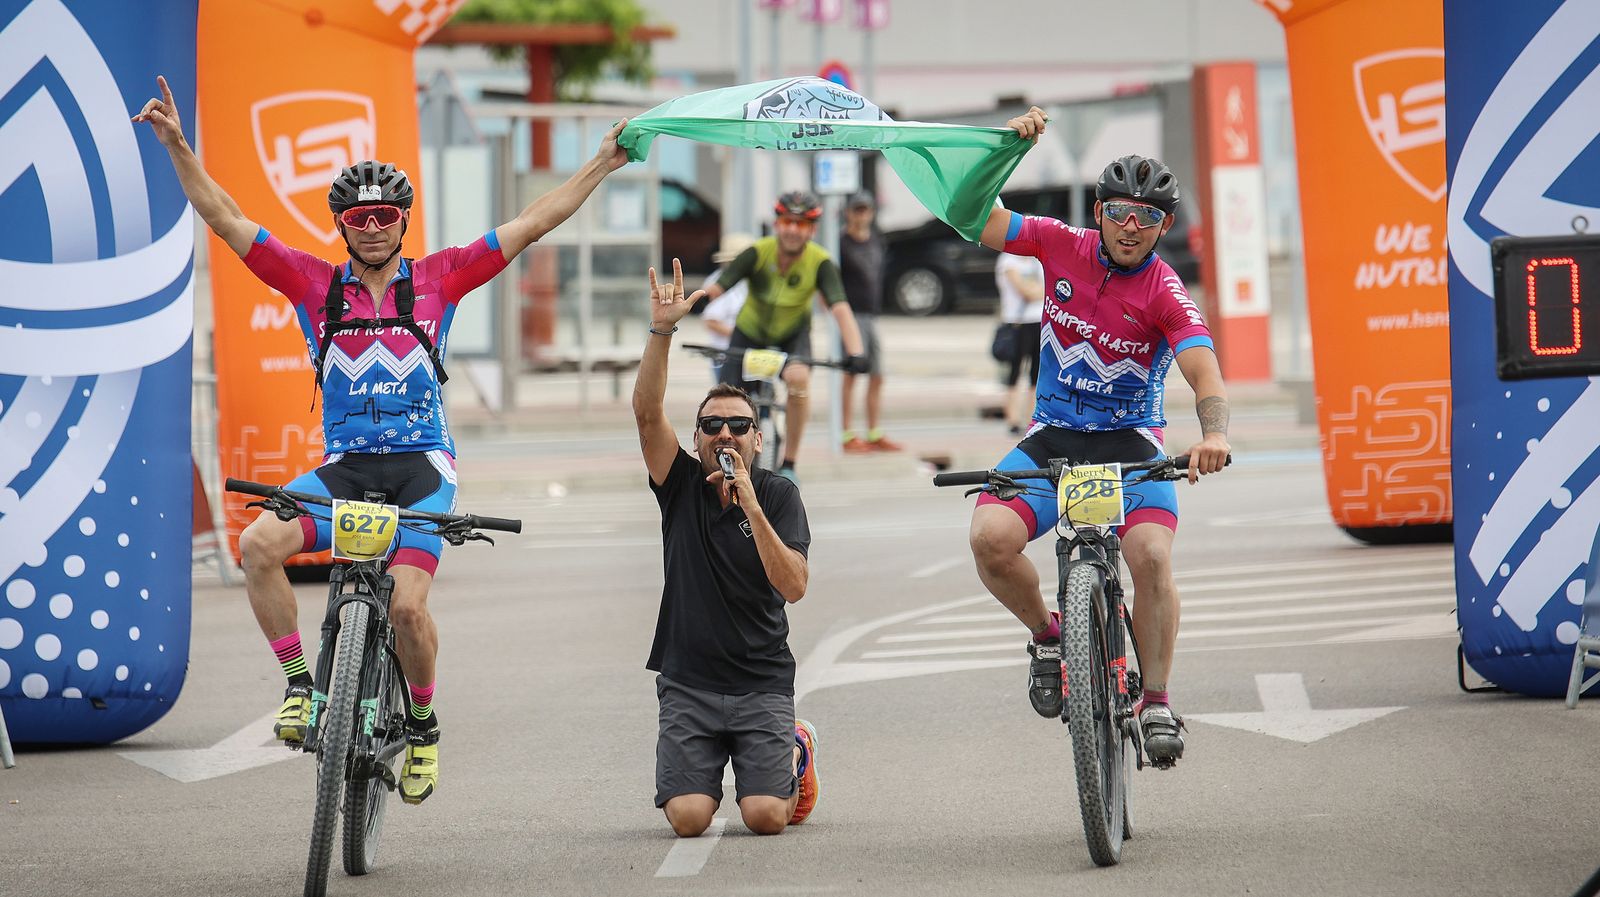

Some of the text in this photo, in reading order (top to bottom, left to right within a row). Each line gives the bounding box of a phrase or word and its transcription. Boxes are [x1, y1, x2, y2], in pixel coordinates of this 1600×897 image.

[1374, 222, 1433, 254] WE
[1527, 257, 1581, 355] 0
[1044, 296, 1151, 355] SIEMPRE HASTA
[348, 381, 408, 396] LA META
[1057, 369, 1114, 395] LA META
[1071, 468, 1106, 480] Sherry
[1064, 480, 1116, 500] 628
[347, 503, 383, 514] Sherry
[339, 512, 391, 535] 627
